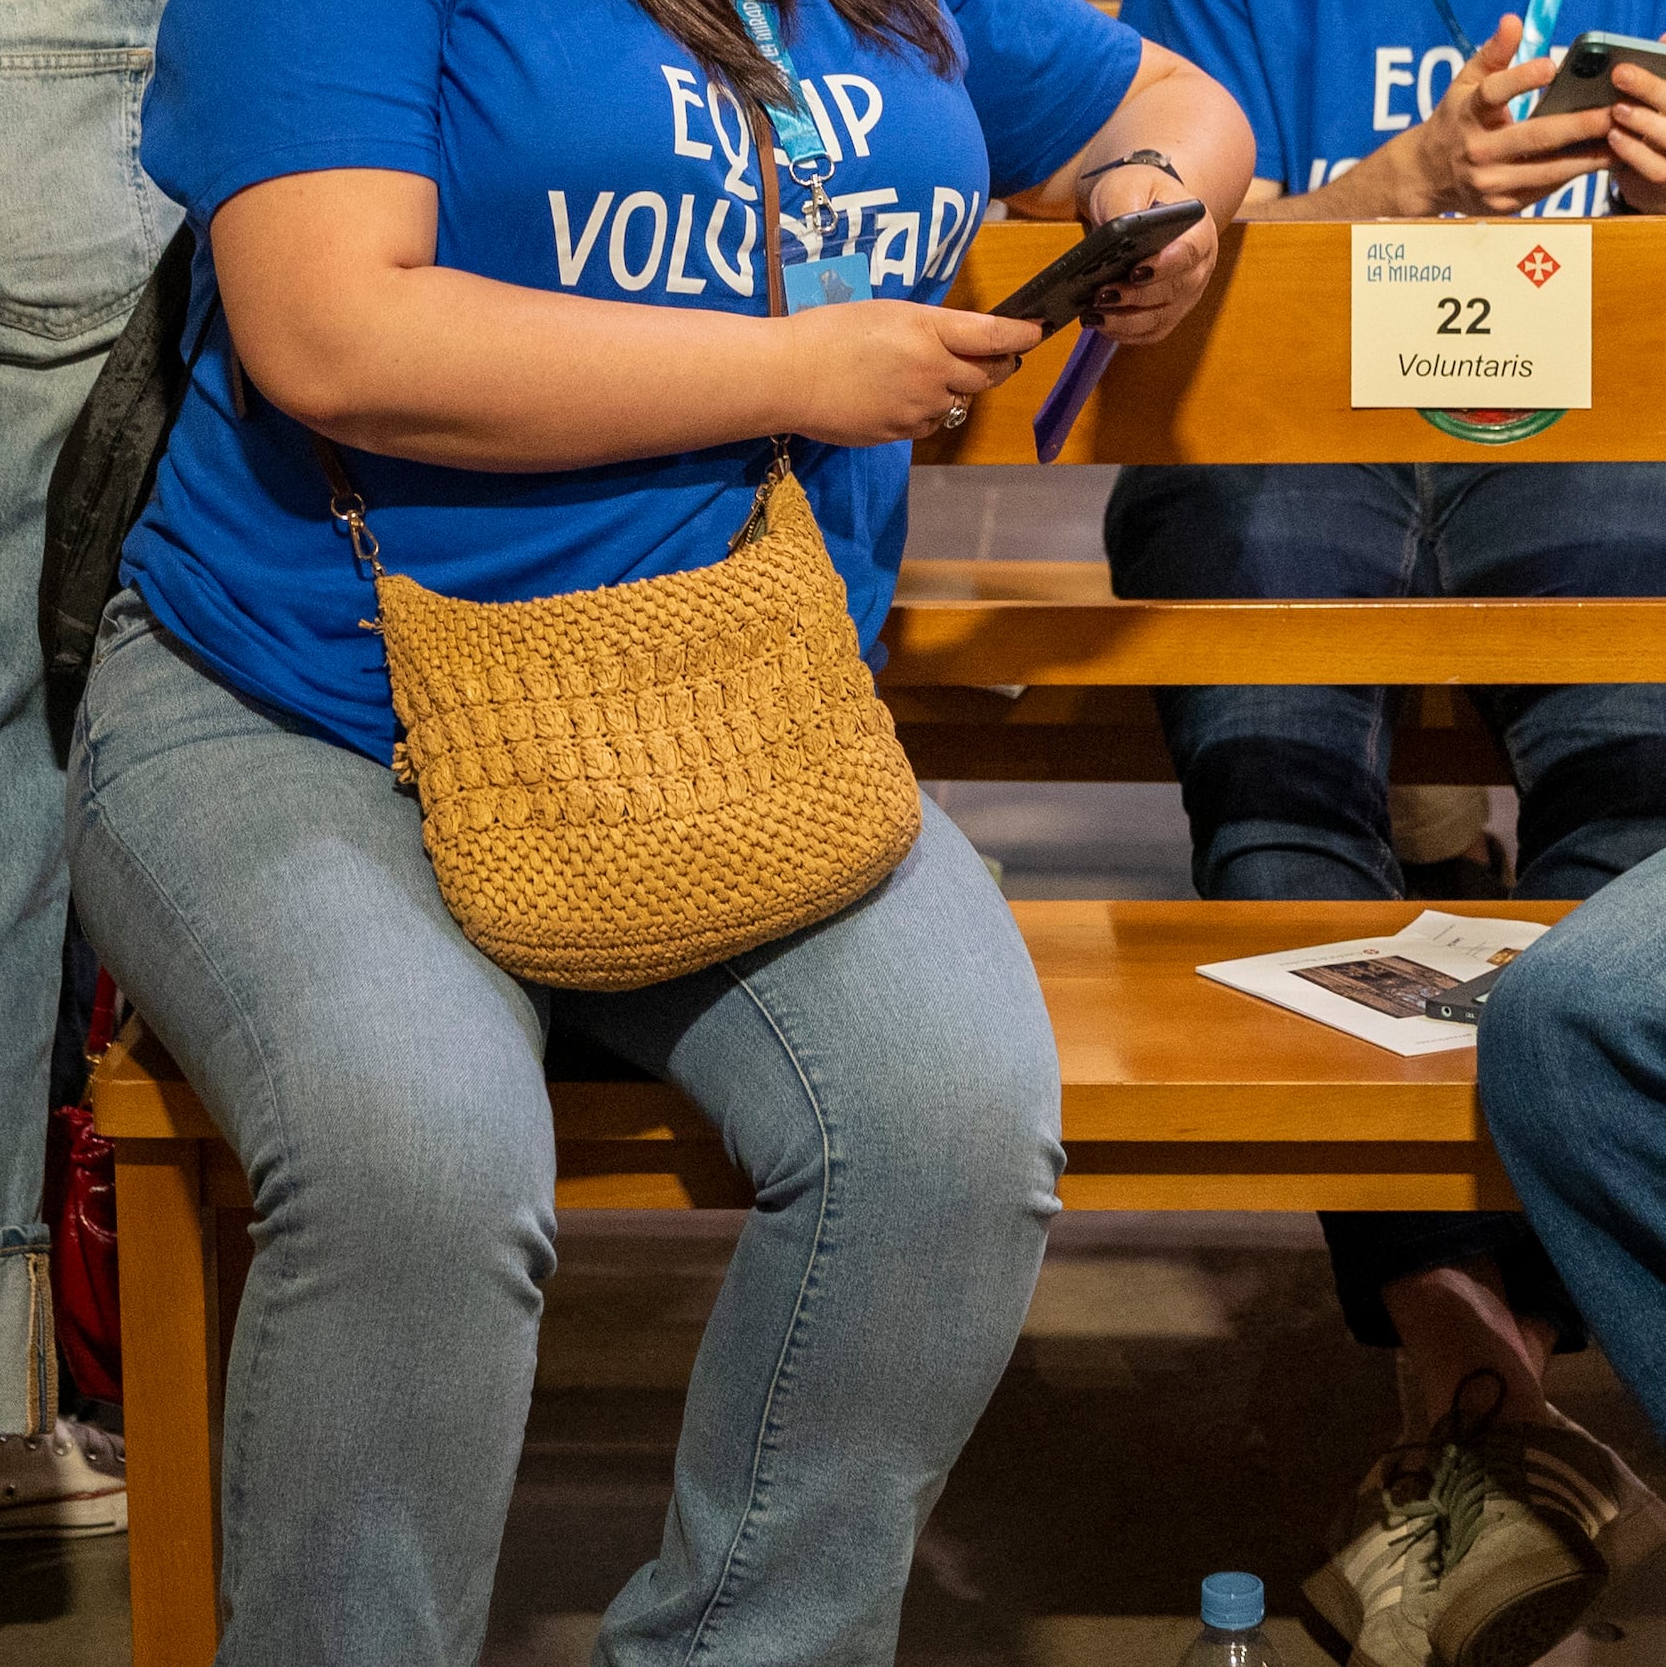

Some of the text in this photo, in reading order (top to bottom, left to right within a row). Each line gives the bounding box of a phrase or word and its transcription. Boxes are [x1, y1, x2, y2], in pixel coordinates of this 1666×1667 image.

[1366, 242, 1405, 264] ALÇA
[1366, 264, 1452, 282] LA MIRADA
[1436, 297, 1492, 335] 22
[1398, 353, 1534, 377] Voluntaris
